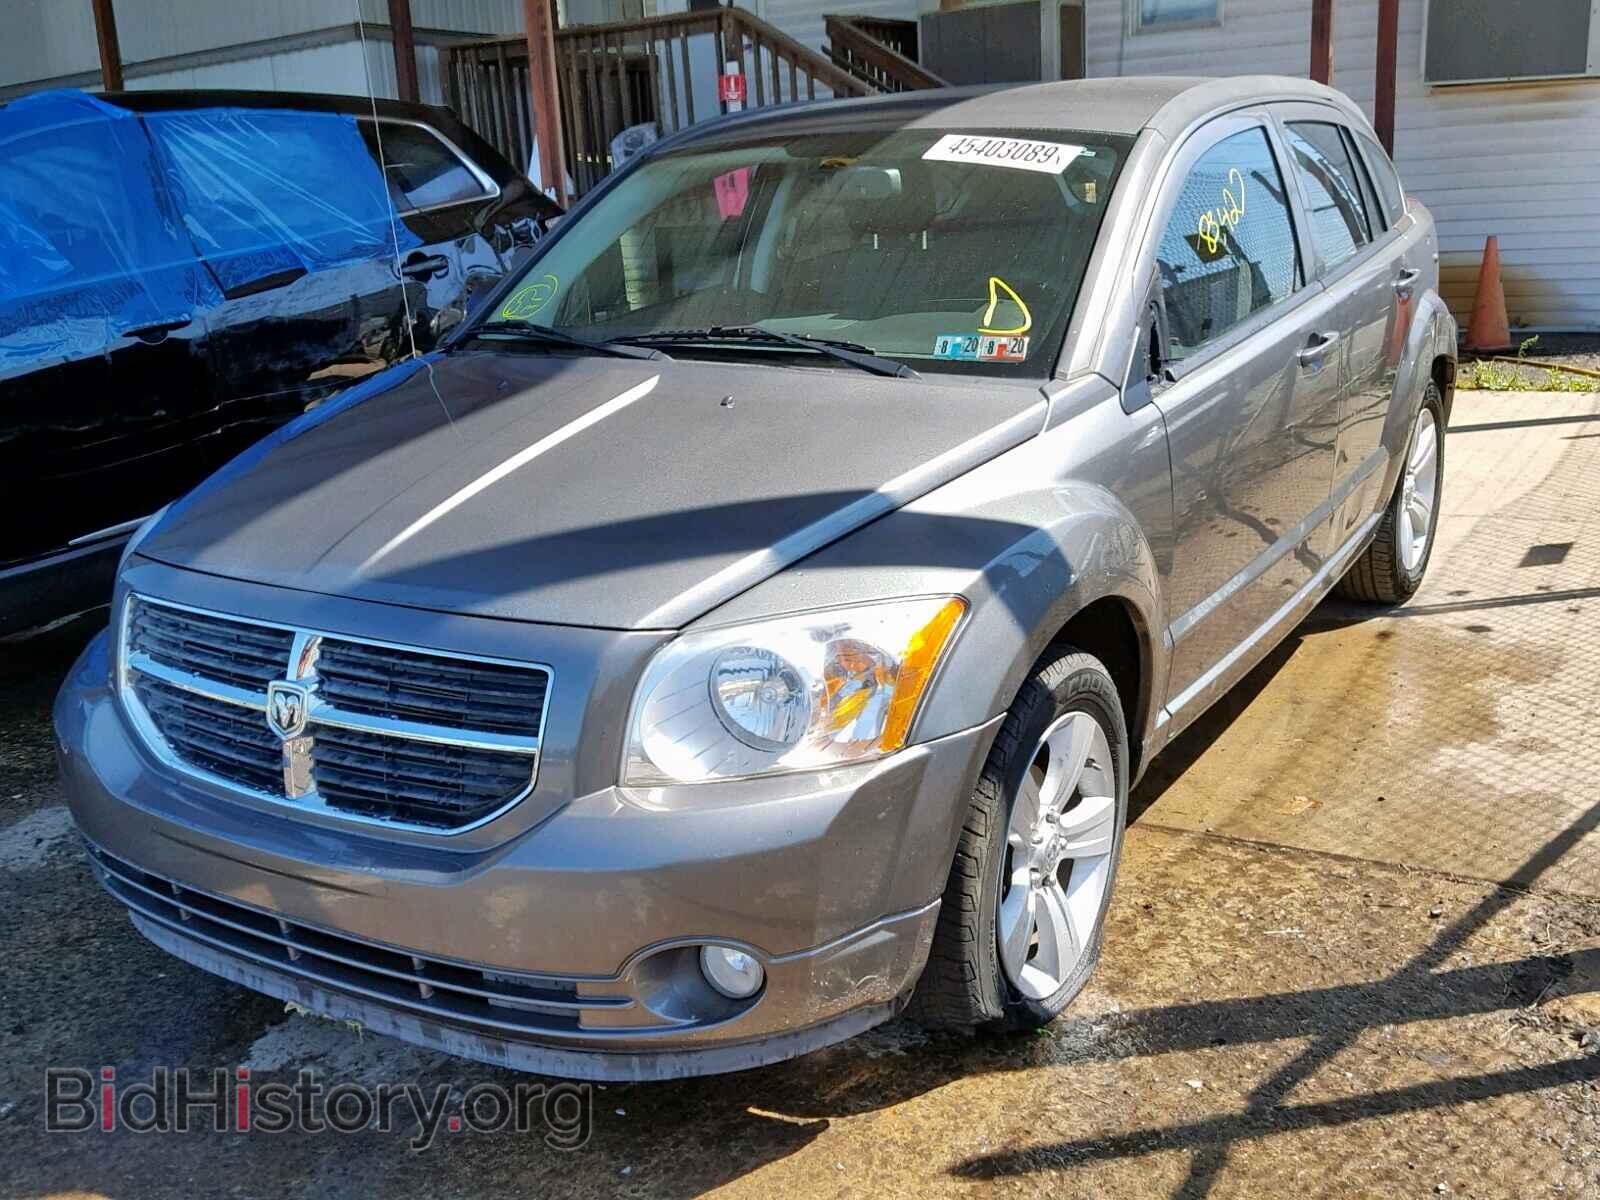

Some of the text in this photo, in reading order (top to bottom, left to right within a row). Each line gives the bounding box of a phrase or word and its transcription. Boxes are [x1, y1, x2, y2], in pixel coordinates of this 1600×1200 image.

[940, 337, 979, 354] 8 20
[987, 337, 1026, 355] 8 20
